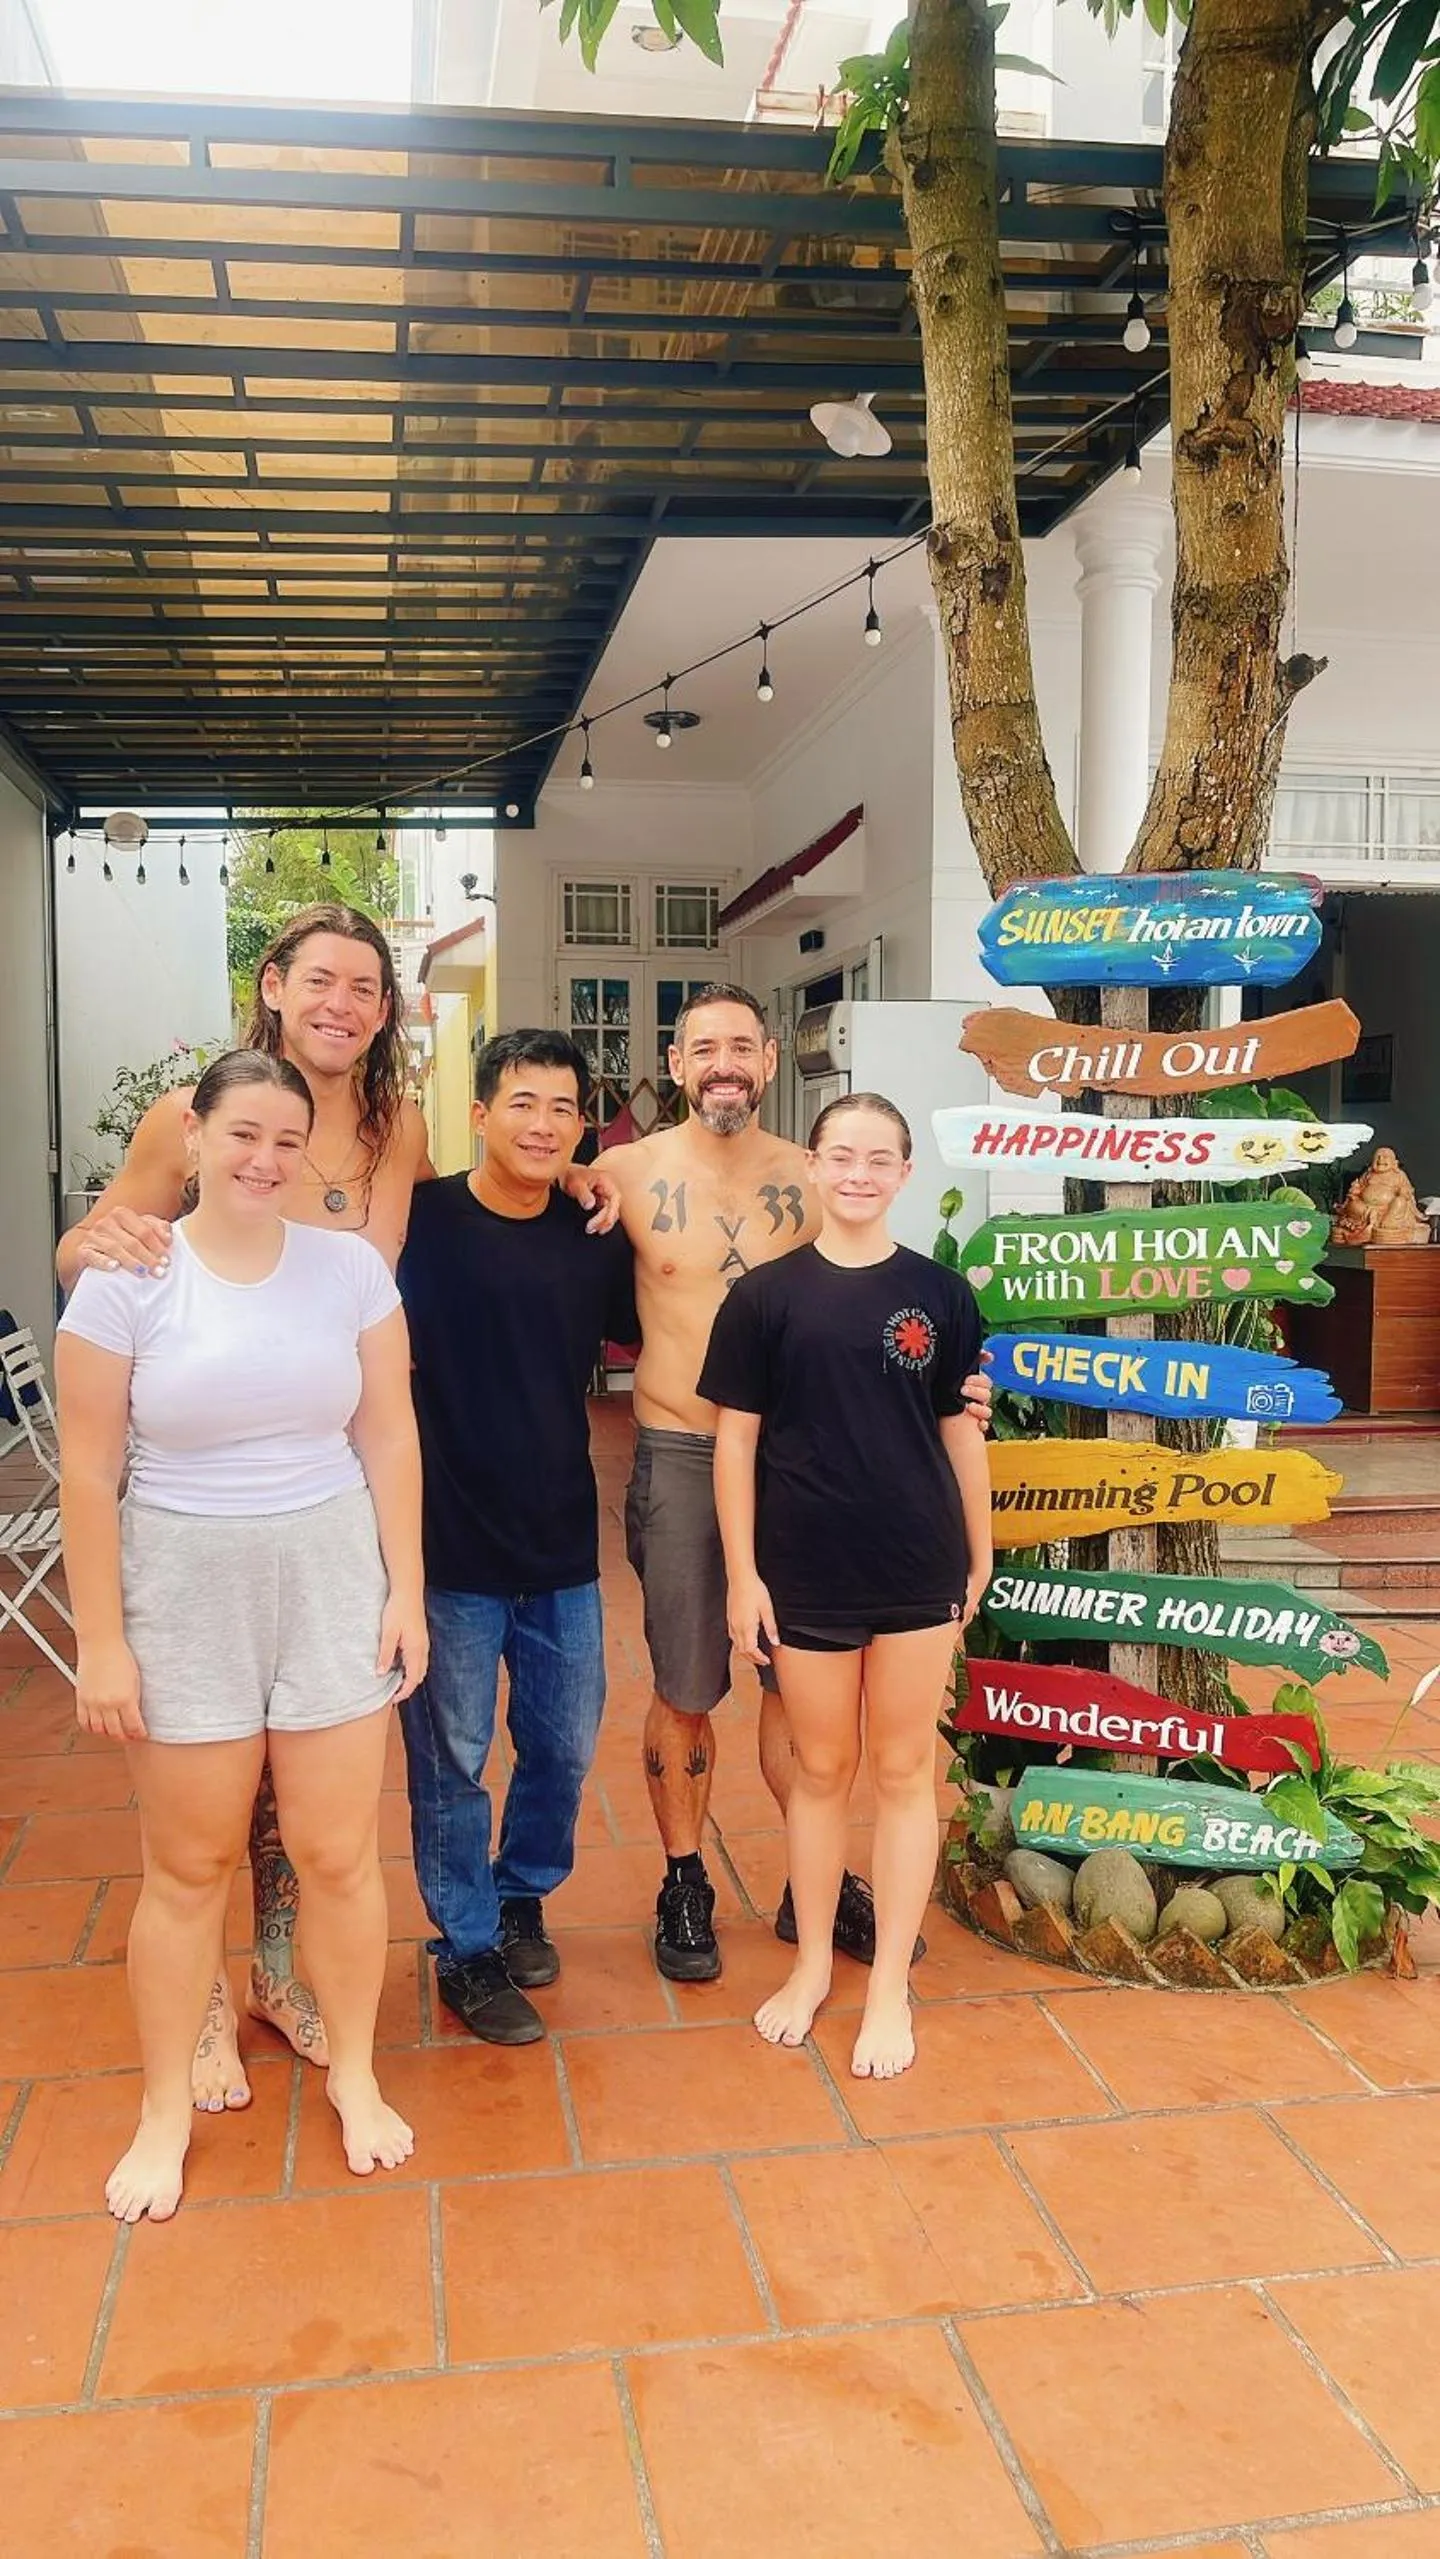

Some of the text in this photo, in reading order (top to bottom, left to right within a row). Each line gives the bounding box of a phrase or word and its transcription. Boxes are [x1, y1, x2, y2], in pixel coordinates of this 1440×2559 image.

[997, 906, 1125, 946] SUNSET
[1234, 905, 1310, 939] town
[1028, 1038, 1259, 1084] Chill Out
[972, 1124, 1216, 1165] HAPPINESS
[993, 1224, 1281, 1265] FROM HOI AN
[1002, 1266, 1213, 1301] with LOVE
[1012, 1342, 1210, 1400] CHECK IN
[991, 1472, 1275, 1516] wimming Pool
[987, 1576, 1320, 1647] SUMMER HOLIDAY
[983, 1686, 1225, 1756] Wonderful
[1020, 1799, 1323, 1860] AN BANG BEACH
